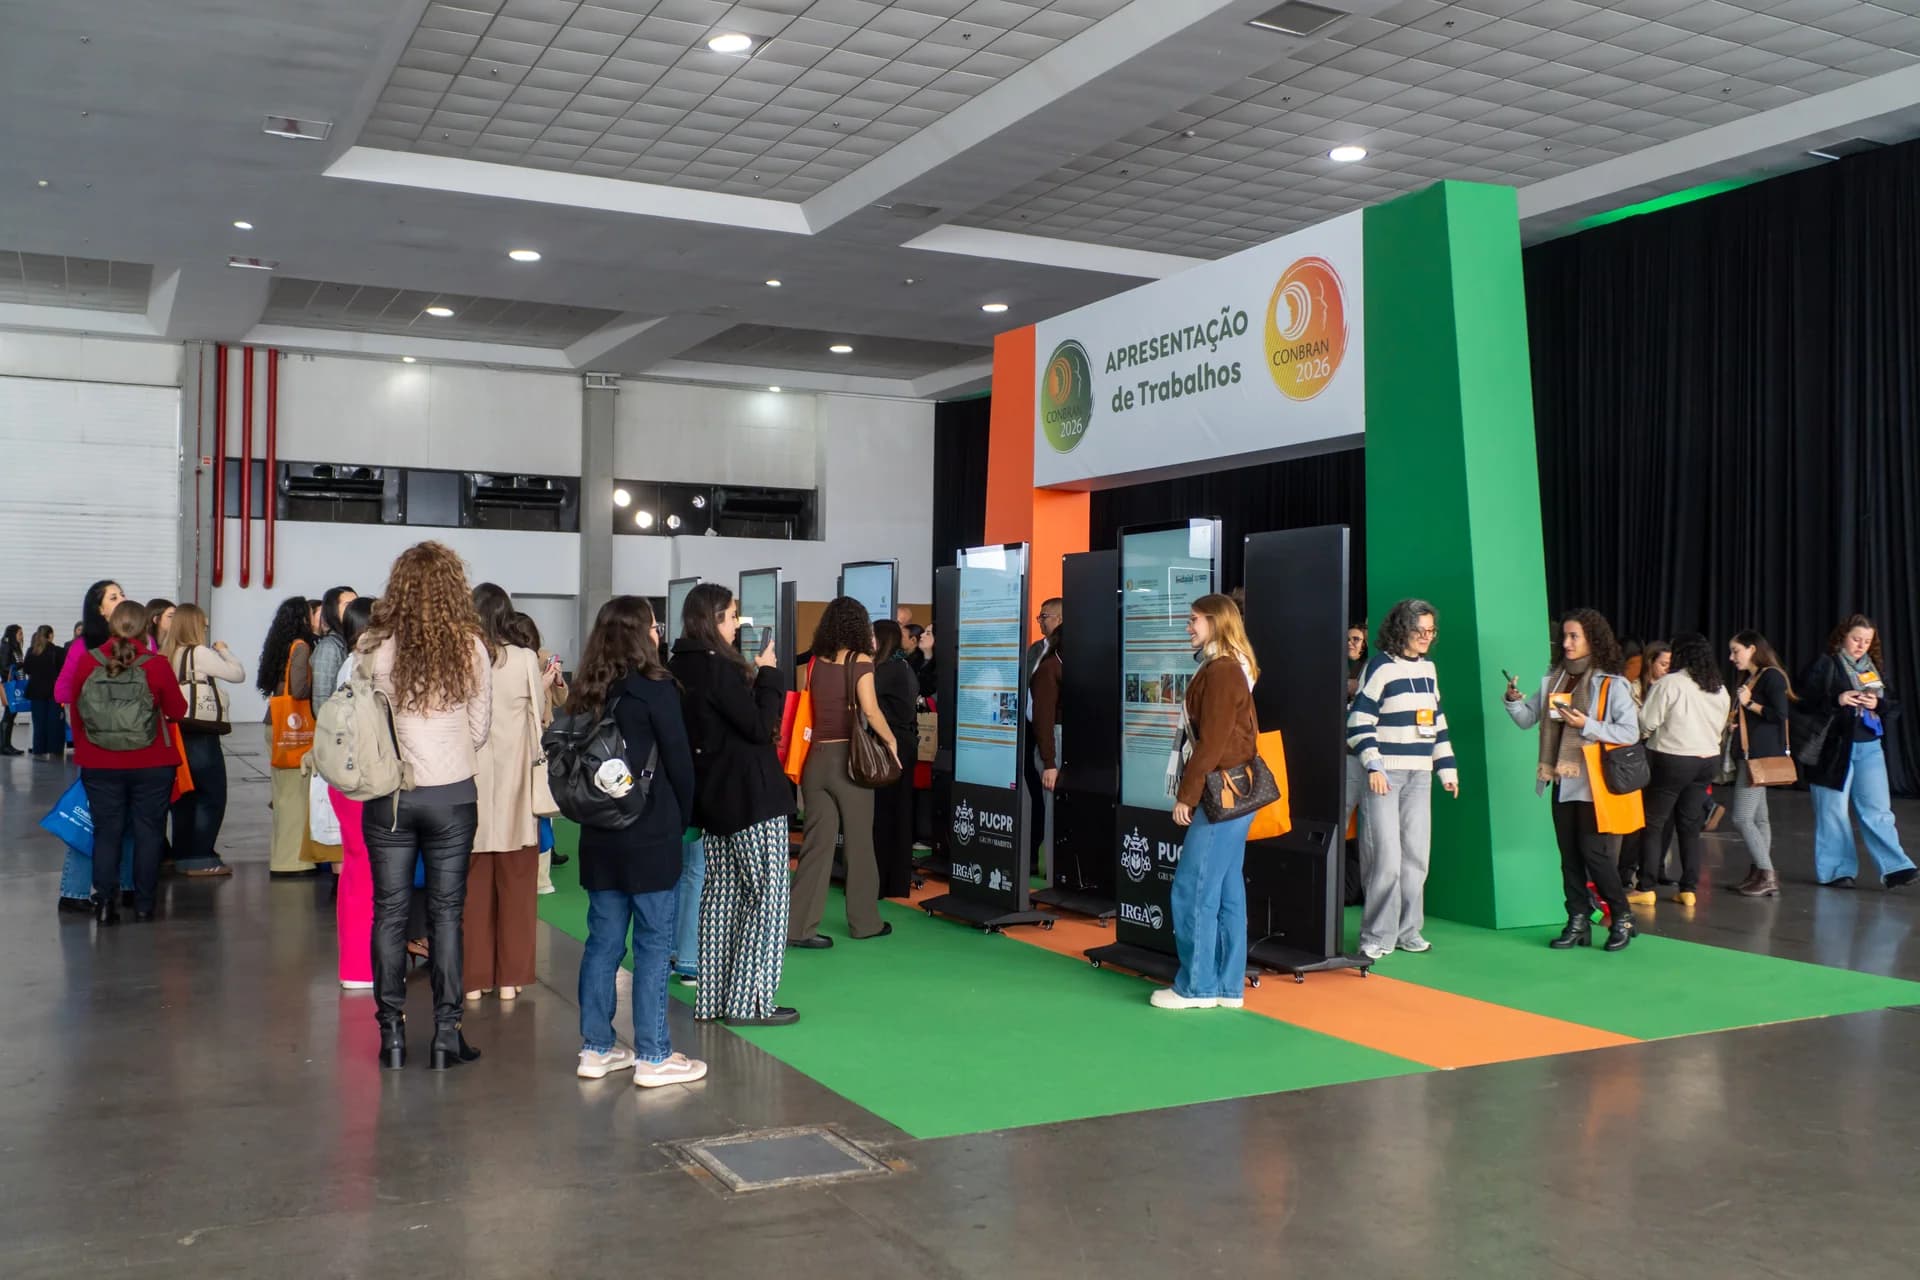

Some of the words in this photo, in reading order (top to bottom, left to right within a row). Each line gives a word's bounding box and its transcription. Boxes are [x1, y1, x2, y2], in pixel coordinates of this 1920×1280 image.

[1105, 305, 1249, 374] APRESENTAÇÃO
[1273, 338, 1330, 367] CONBRAN
[1295, 356, 1331, 383] 2026
[1111, 383, 1135, 413] de
[1138, 361, 1242, 407] Trabalhos
[1060, 417, 1083, 438] 2026
[979, 810, 1013, 833] PUCPR
[952, 862, 973, 880] IRGA
[1120, 902, 1150, 923] IRGA
